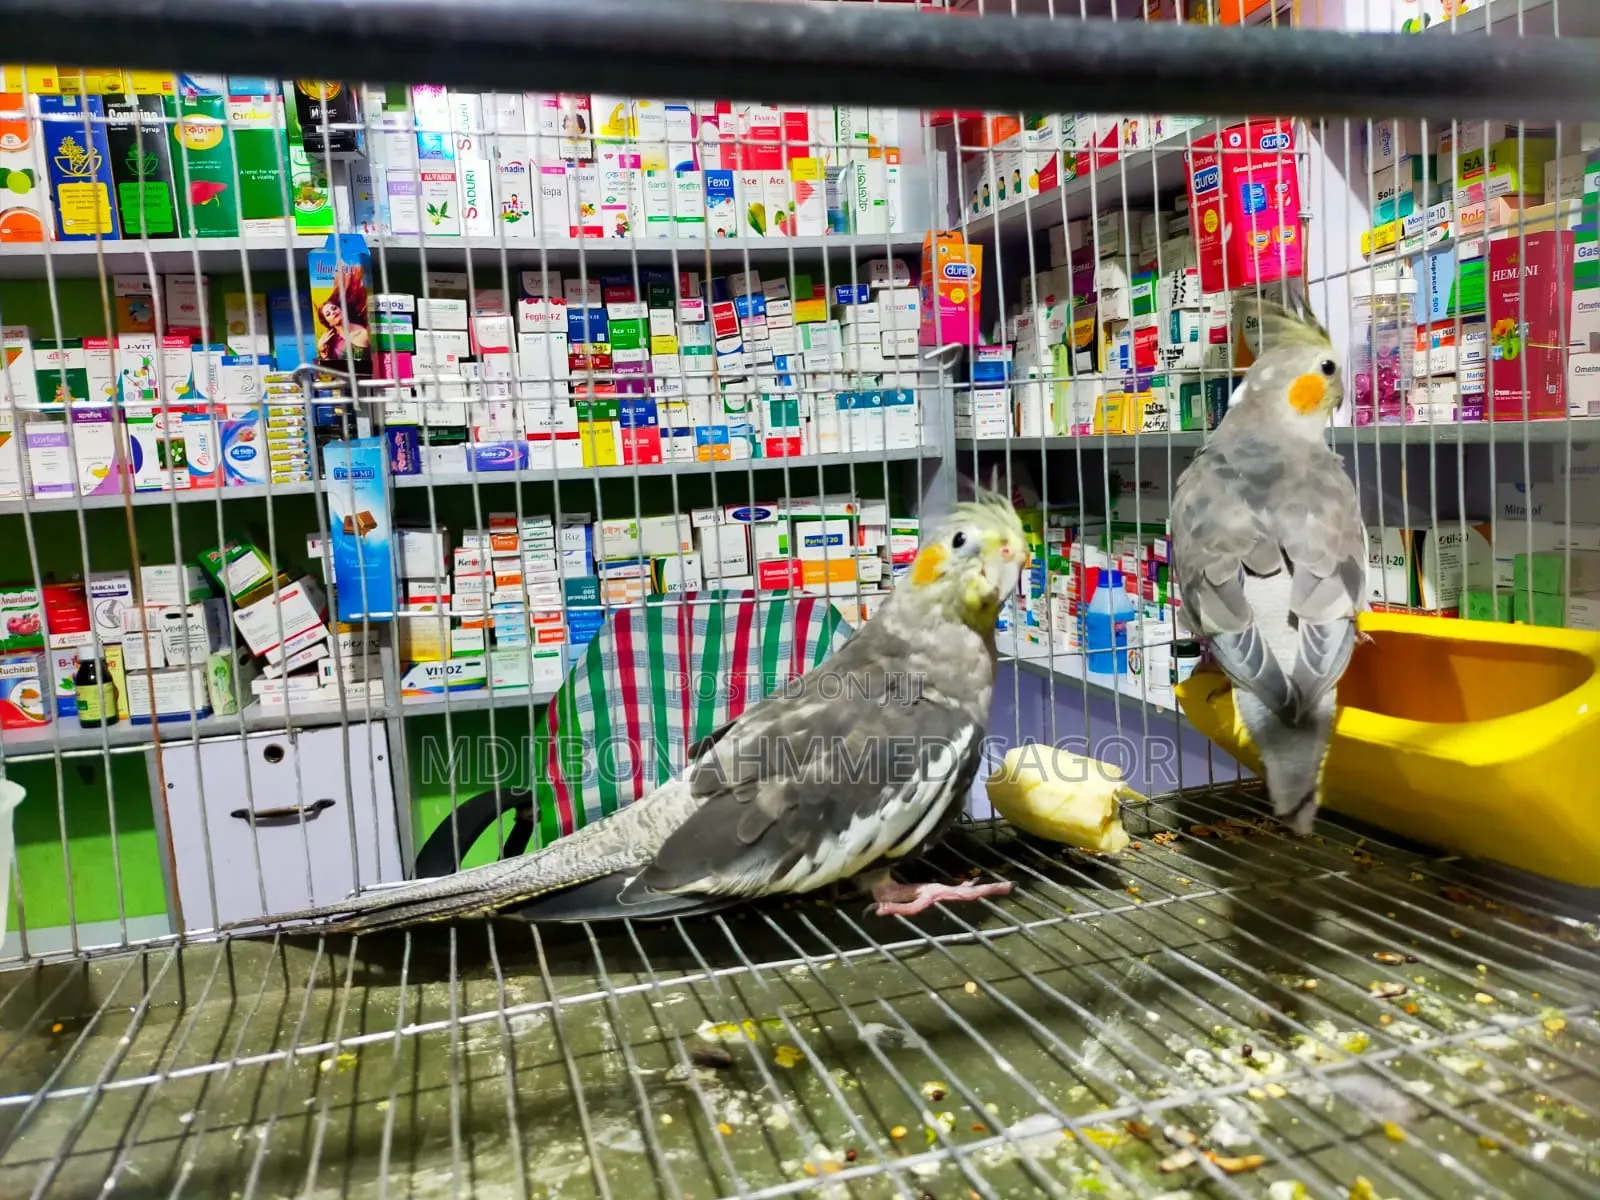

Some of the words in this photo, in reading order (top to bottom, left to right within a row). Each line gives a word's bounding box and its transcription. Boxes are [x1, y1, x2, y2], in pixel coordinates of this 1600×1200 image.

[708, 176, 730, 187] Fexo
[1193, 169, 1220, 191] durex
[466, 170, 478, 220] SADURI
[124, 343, 152, 351] J-VIT
[1504, 503, 1543, 517] Miraof
